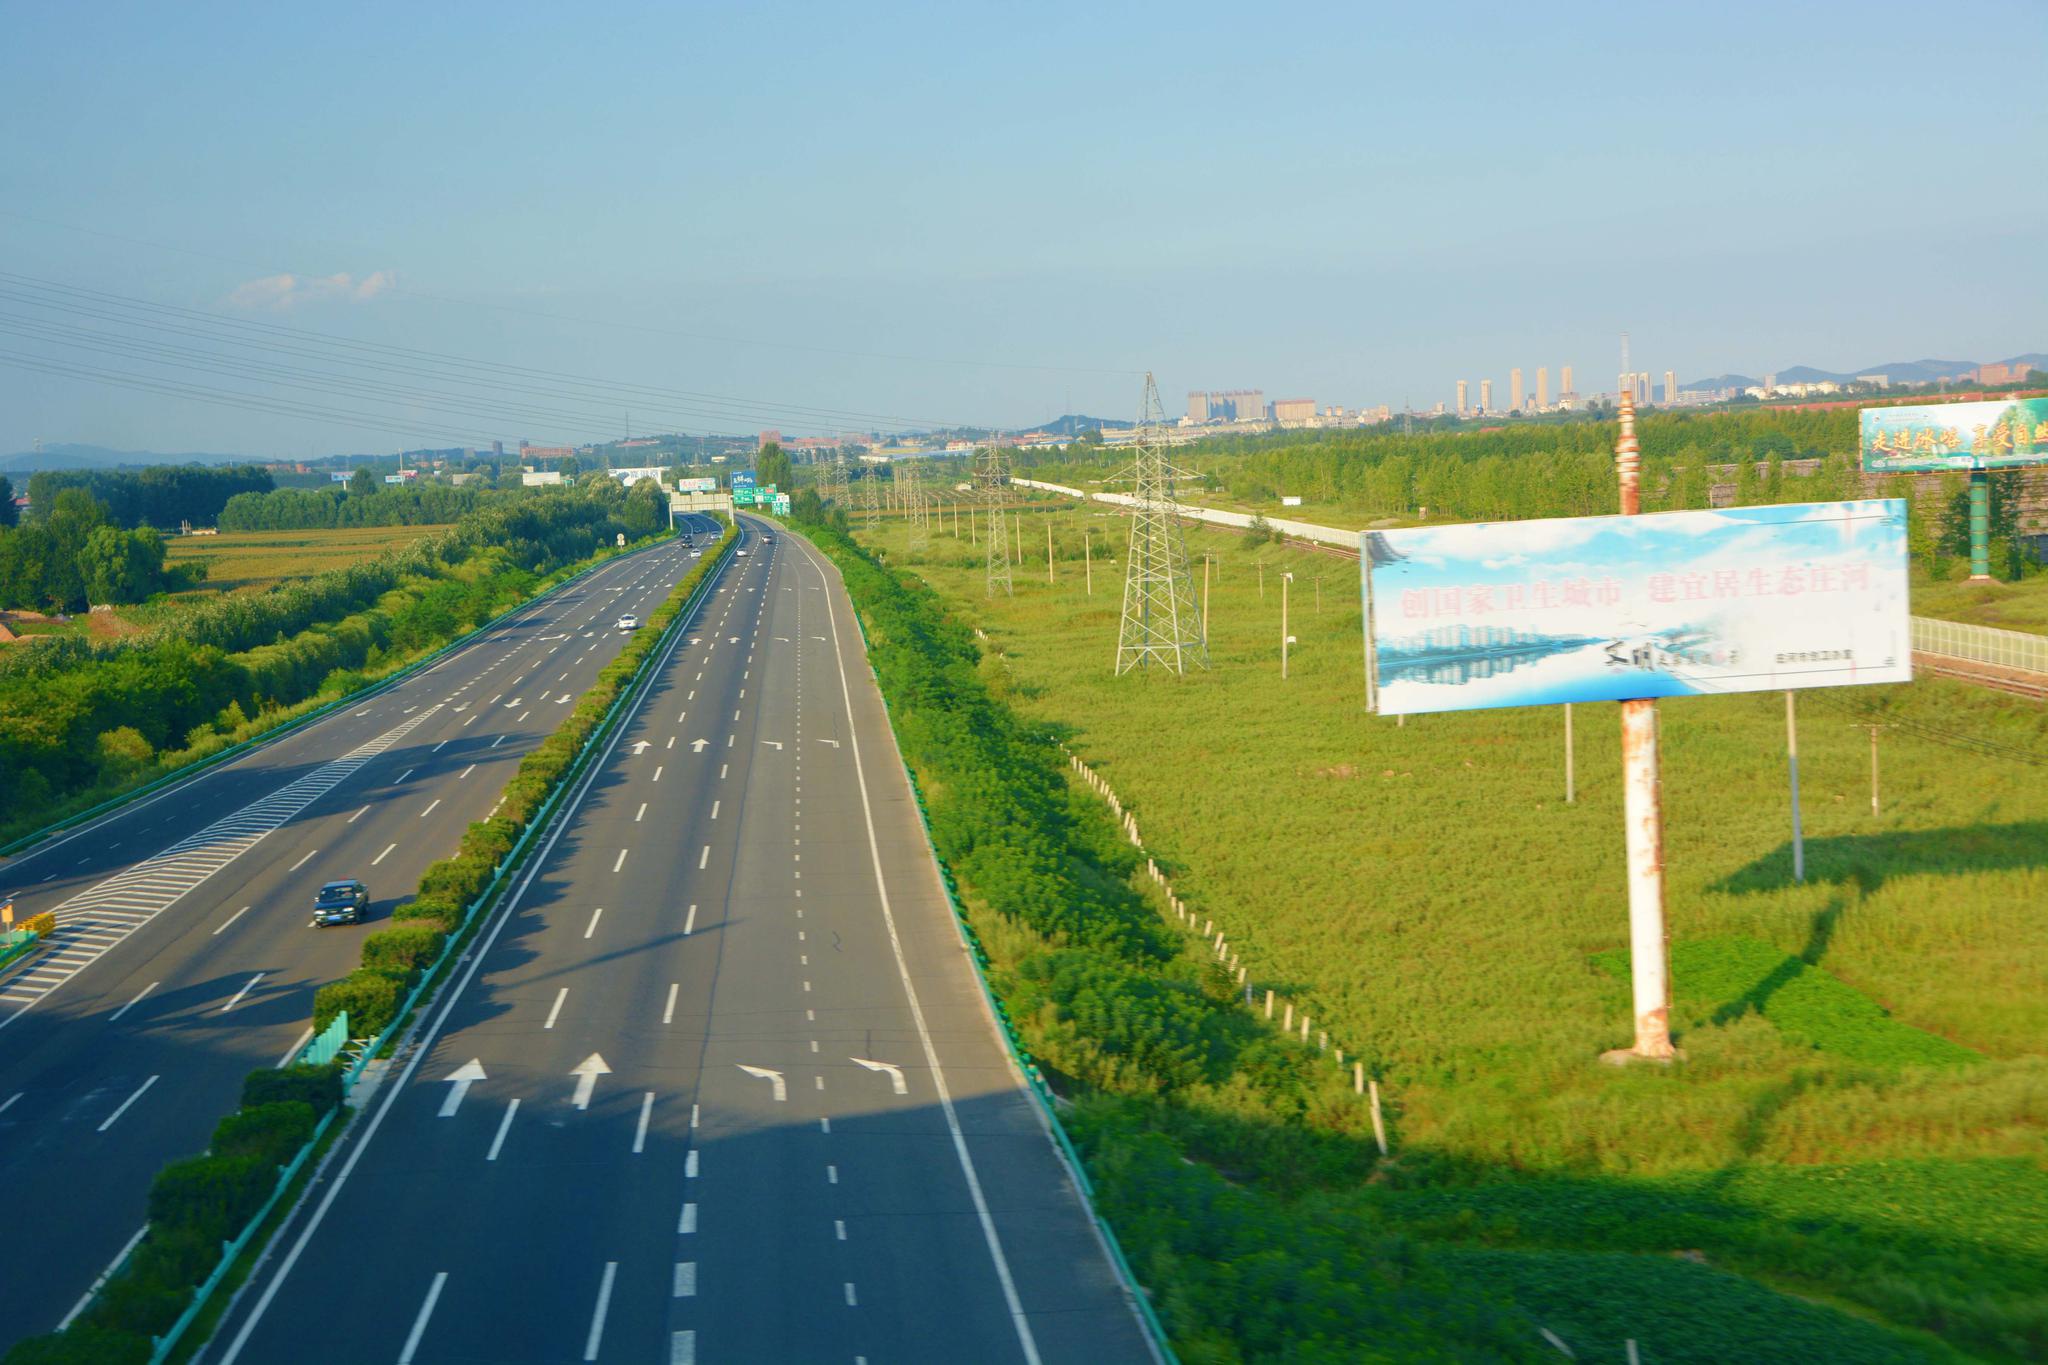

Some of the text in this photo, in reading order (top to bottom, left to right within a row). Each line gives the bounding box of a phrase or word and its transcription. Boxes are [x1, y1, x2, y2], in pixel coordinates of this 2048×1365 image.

[1401, 561, 1870, 618] 创国家卫生城市 建宜居生态庄河
